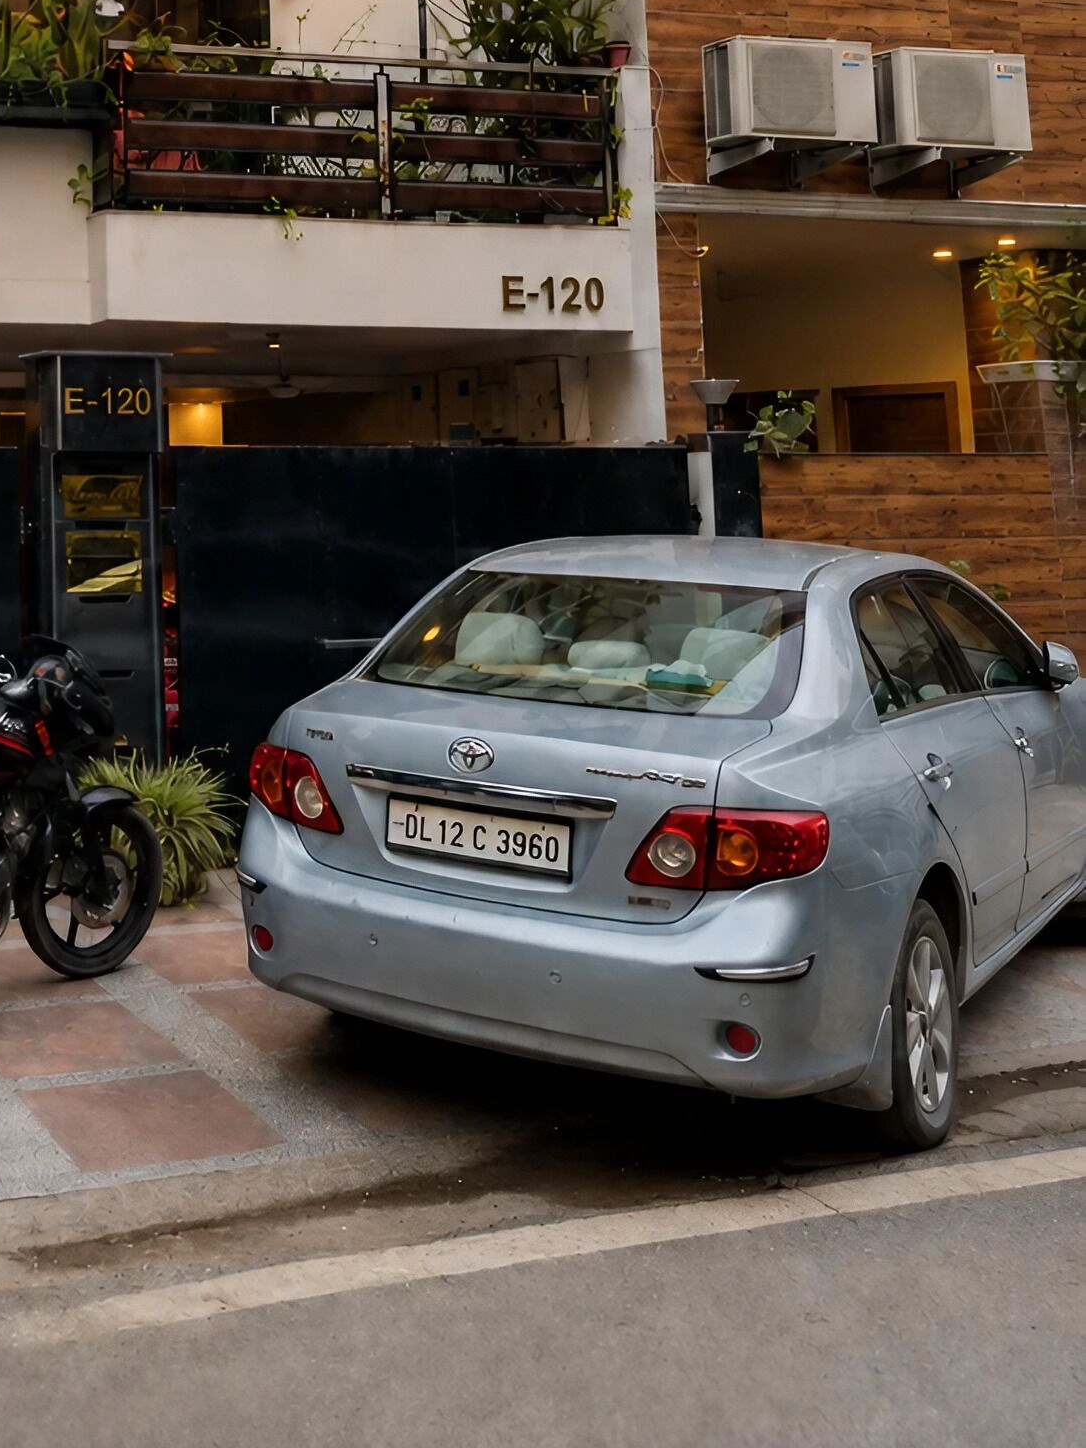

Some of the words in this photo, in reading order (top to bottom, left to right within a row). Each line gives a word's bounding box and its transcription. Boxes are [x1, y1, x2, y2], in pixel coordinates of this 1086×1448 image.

[501, 275, 604, 313] E-120
[64, 387, 152, 416] E-120
[472, 825, 487, 851] C
[496, 829, 560, 863] 3960
